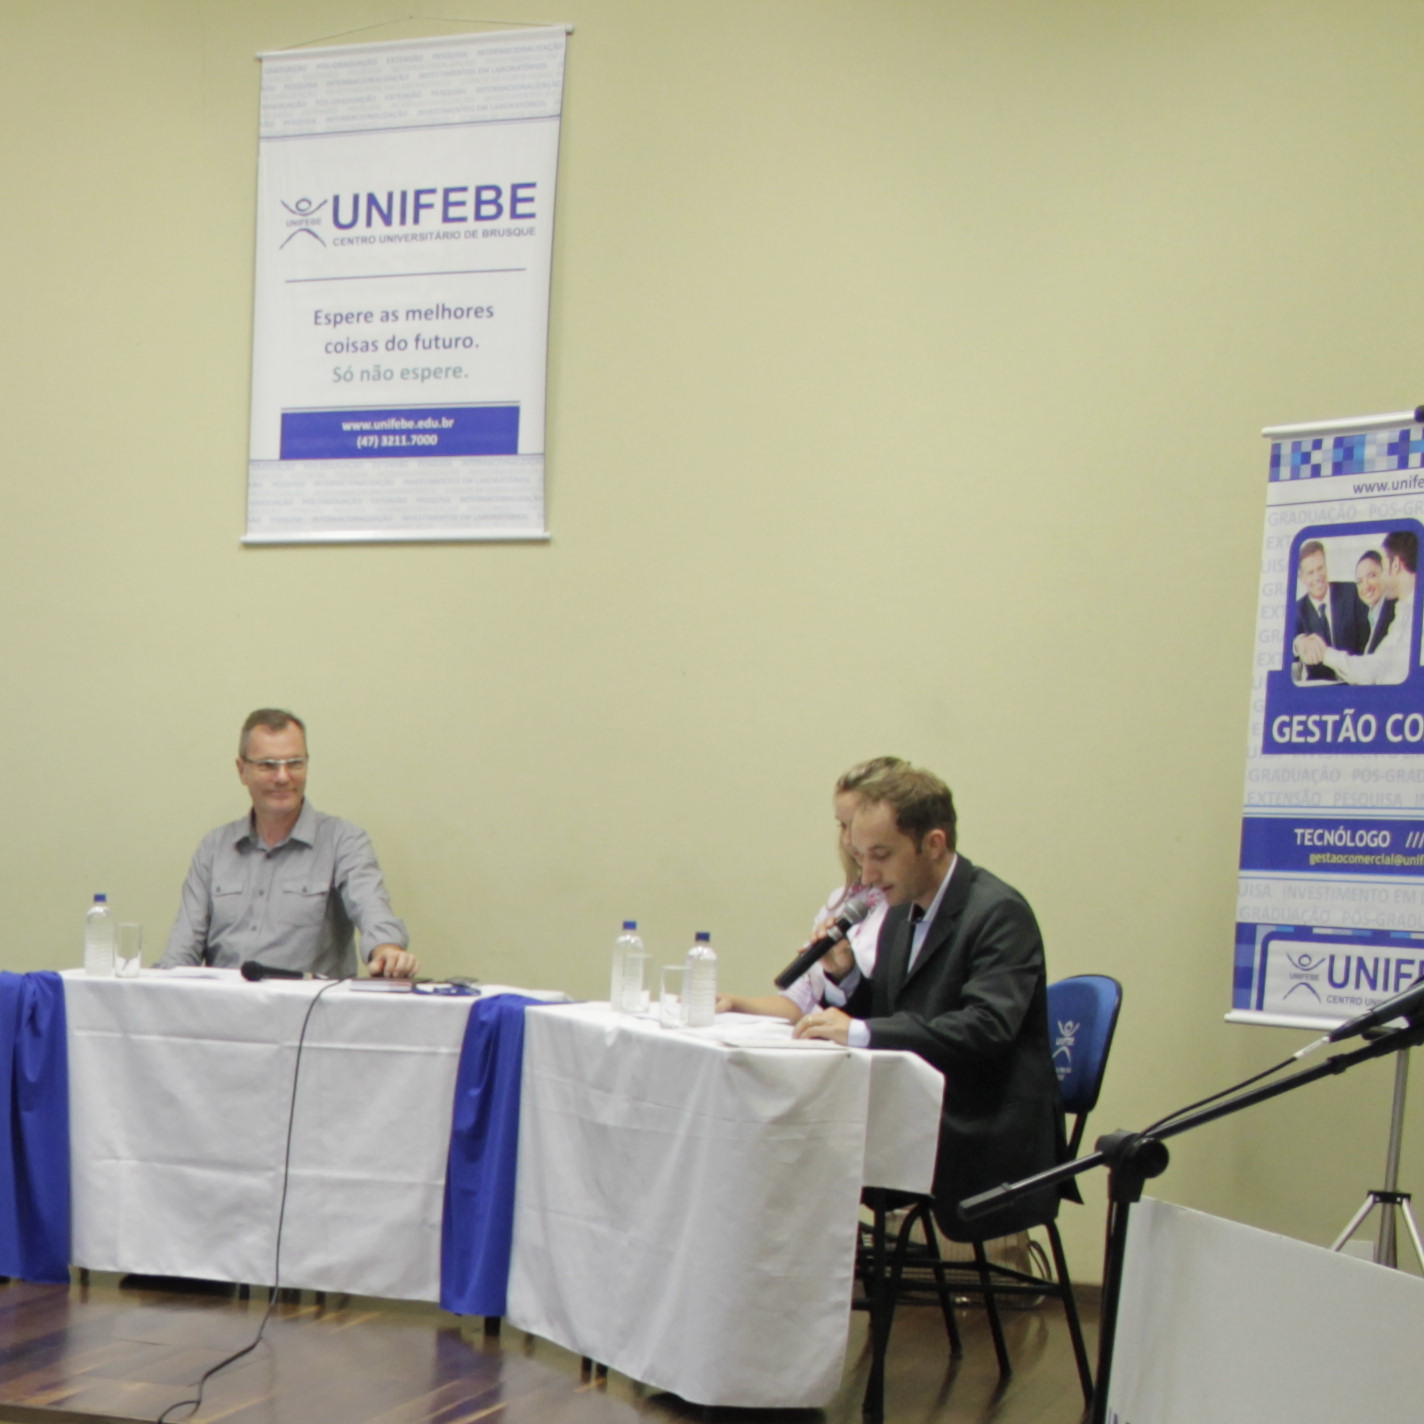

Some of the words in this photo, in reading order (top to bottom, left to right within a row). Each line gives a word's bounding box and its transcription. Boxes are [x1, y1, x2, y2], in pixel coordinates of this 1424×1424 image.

[332, 181, 537, 231] UNIFEBE
[332, 234, 376, 247] CENTRO
[378, 229, 461, 245] UNIVERSITÁRIO
[464, 228, 478, 240] DE
[481, 226, 536, 239] BRUSQUE
[313, 308, 374, 329] Espere
[380, 309, 399, 323] as
[405, 302, 494, 322] melhores
[324, 336, 379, 354] coisas
[384, 334, 408, 352] do
[414, 333, 480, 351] futuro.
[332, 364, 354, 384] Só
[360, 364, 394, 382] não
[400, 365, 469, 383] espere.
[341, 416, 455, 431] www.unifebe.edu.br
[356, 434, 379, 449] (47)
[1352, 473, 1424, 494] www.unife
[1268, 505, 1357, 527] GRADUAÇÃO
[1271, 707, 1377, 744] GESTÃO
[1385, 712, 1424, 744] CO
[1247, 766, 1341, 785] GRADUAÇÃO
[1333, 791, 1403, 808] PESQUISA
[1294, 825, 1391, 848] TECNÓLOGO
[1308, 852, 1424, 867] gestaocomercial@unif
[1283, 886, 1389, 903] INVESTIMENTO
[1239, 906, 1331, 926] GRADUAÇÃO
[1327, 954, 1424, 993] UNIF
[1326, 995, 1363, 1006] CENTRO
